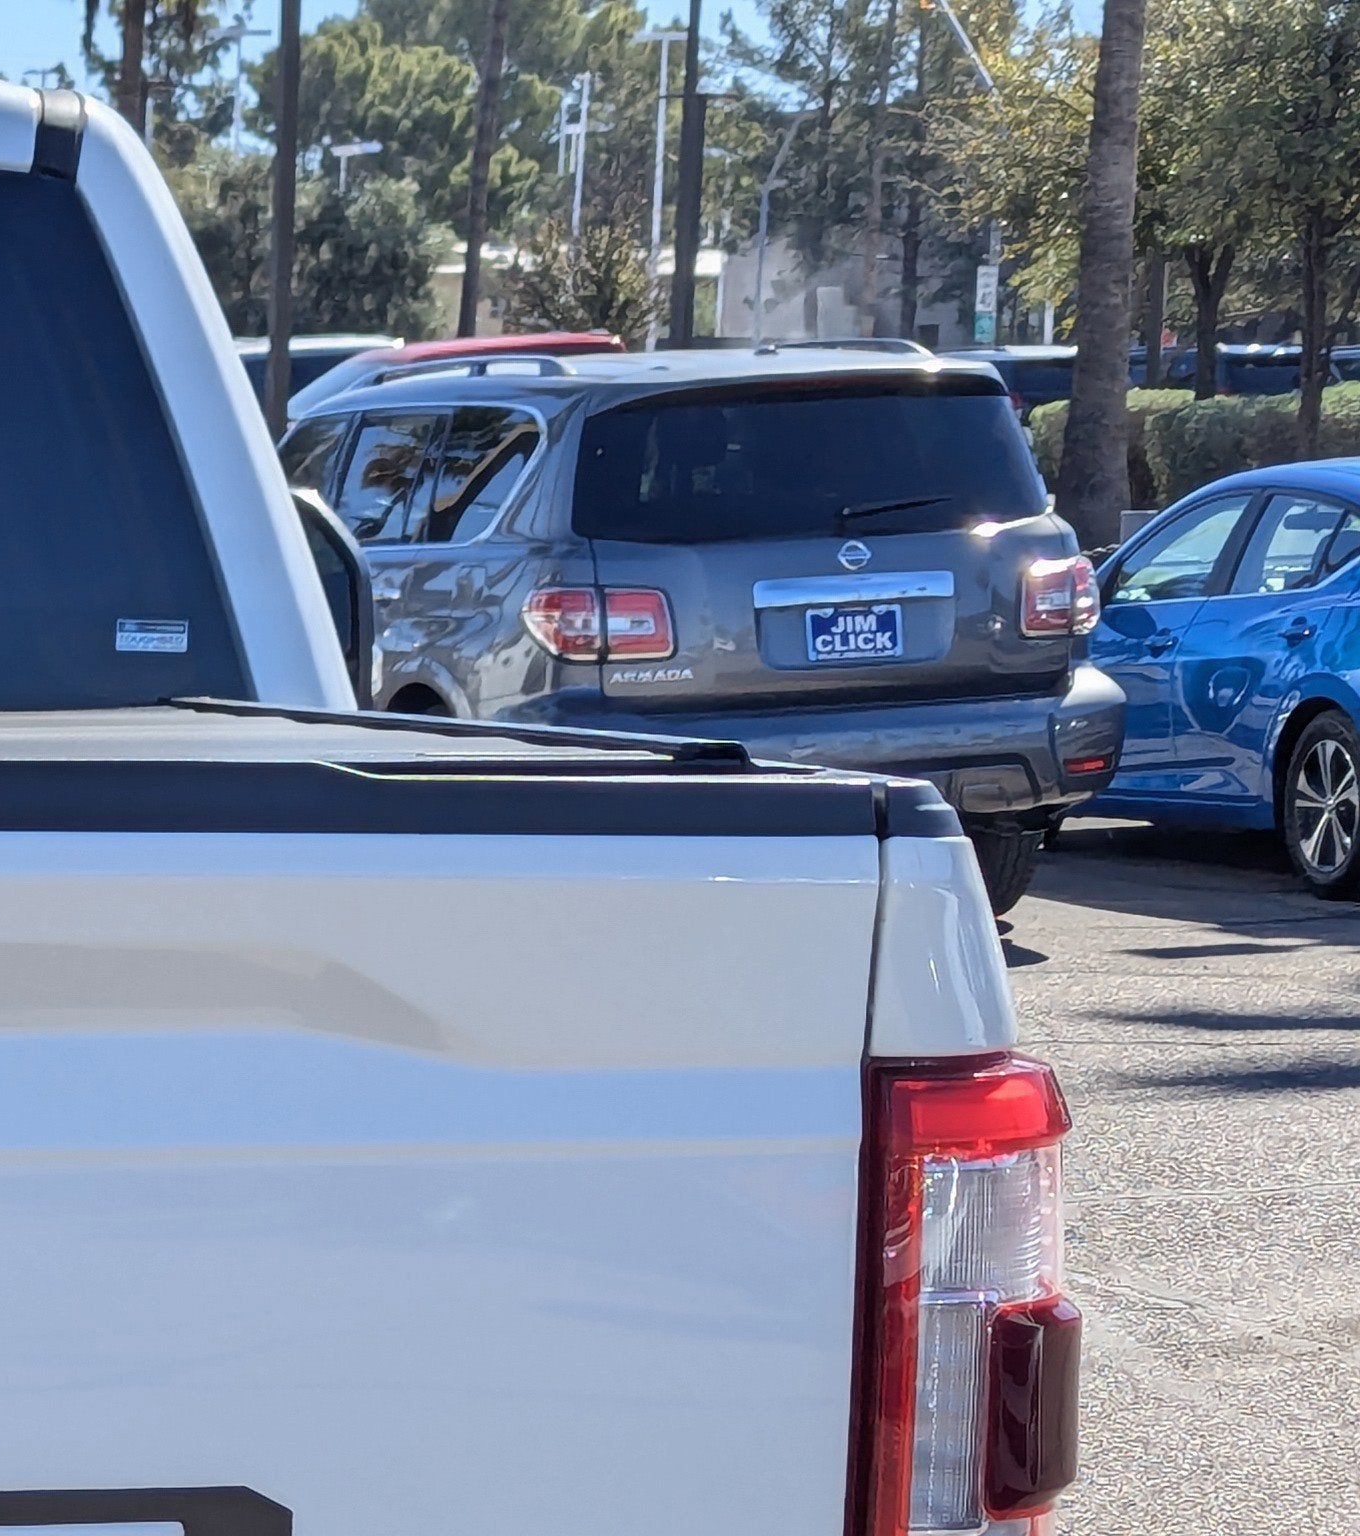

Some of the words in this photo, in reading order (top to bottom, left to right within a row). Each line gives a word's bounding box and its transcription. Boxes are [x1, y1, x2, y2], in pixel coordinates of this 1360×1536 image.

[831, 614, 877, 633] JIM
[815, 631, 893, 652] CLICK
[609, 668, 694, 684] ARMADA
